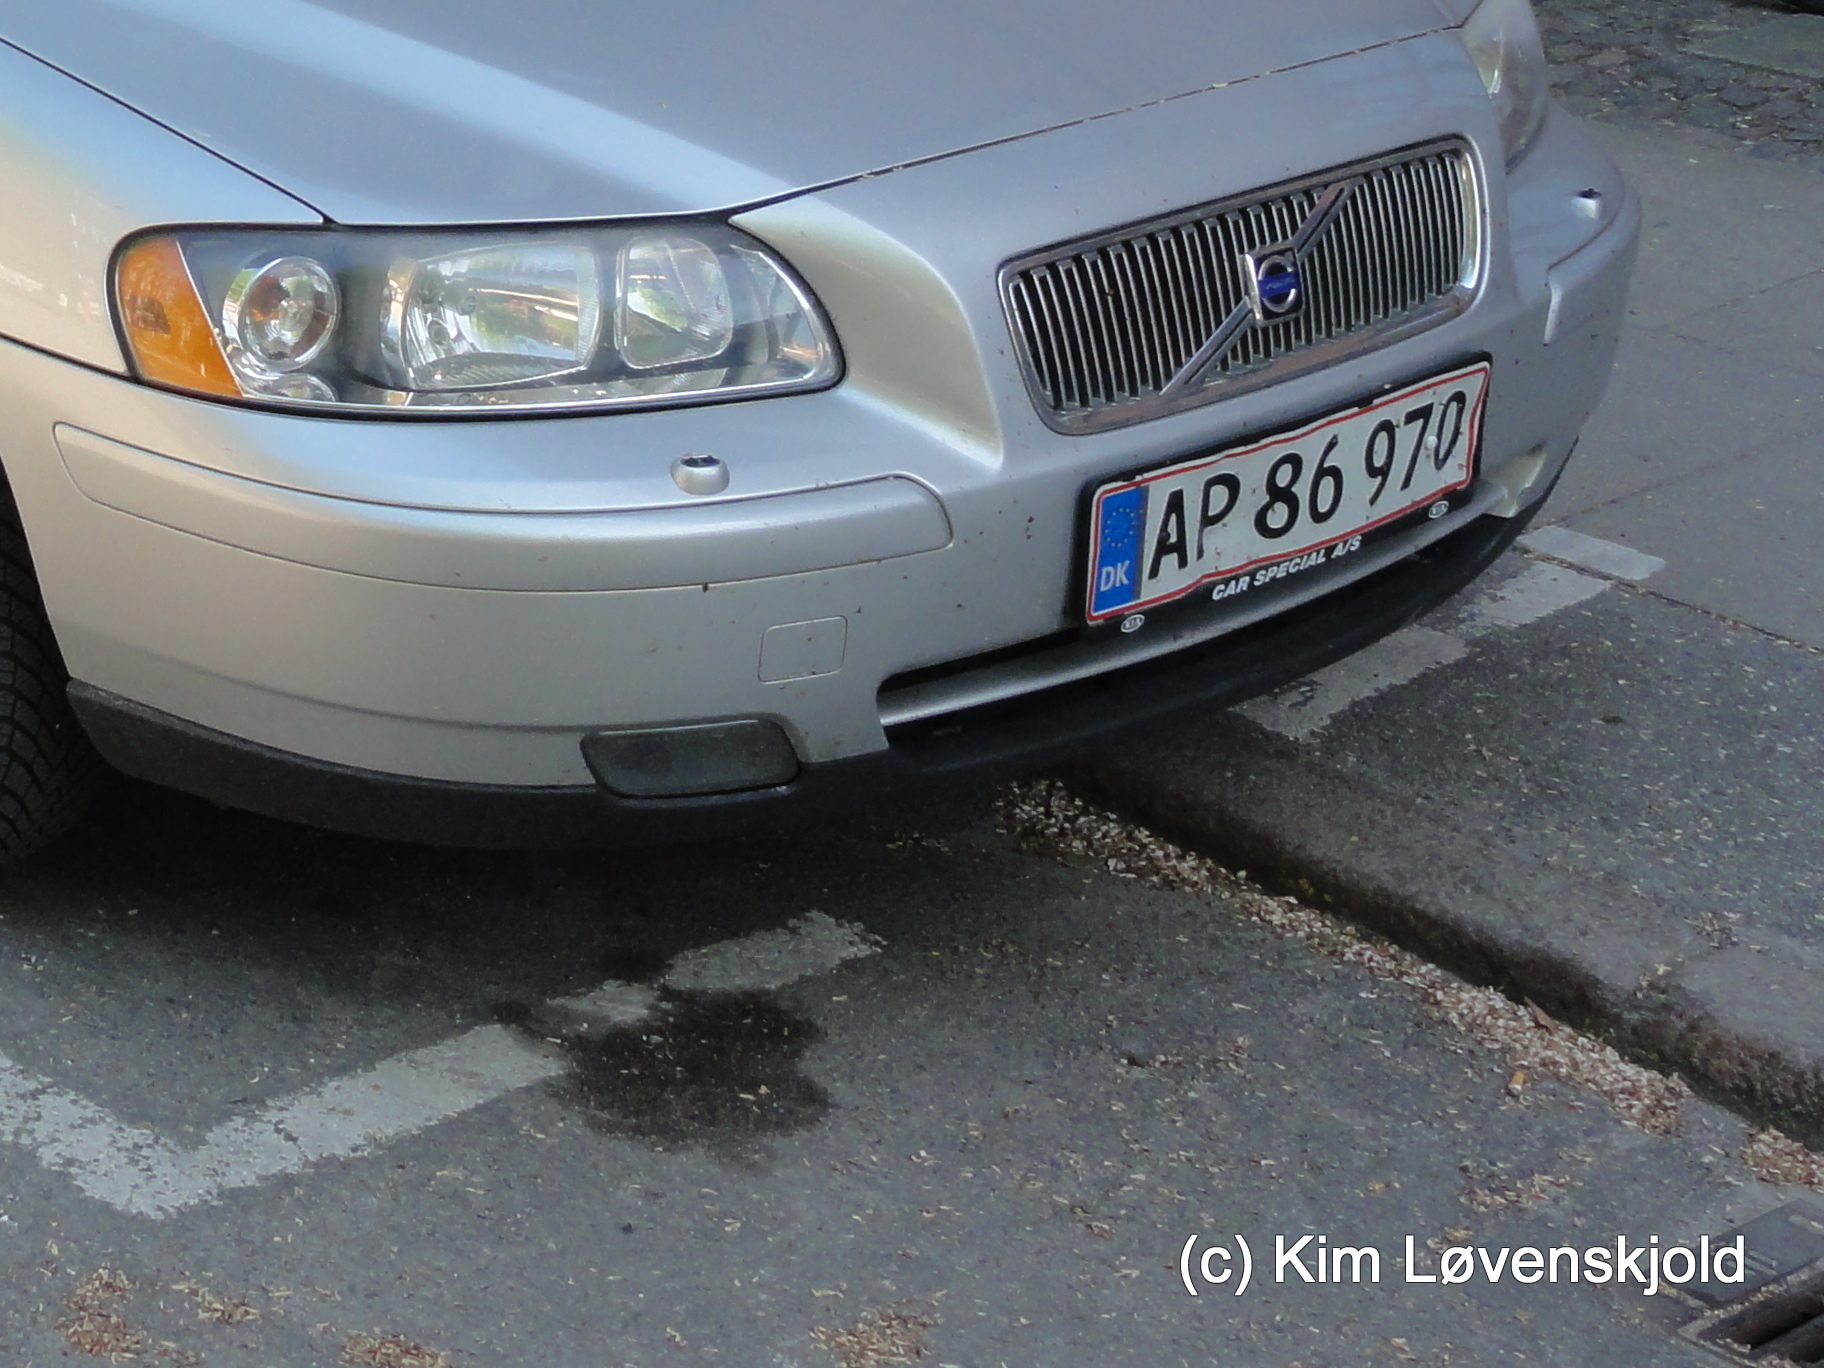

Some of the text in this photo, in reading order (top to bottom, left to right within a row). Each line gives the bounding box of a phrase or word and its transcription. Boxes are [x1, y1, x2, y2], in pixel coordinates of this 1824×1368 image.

[1148, 390, 1468, 581] AP 86 970
[1100, 560, 1131, 593] DK
[1212, 535, 1362, 601] CAR SPECIAL A/S
